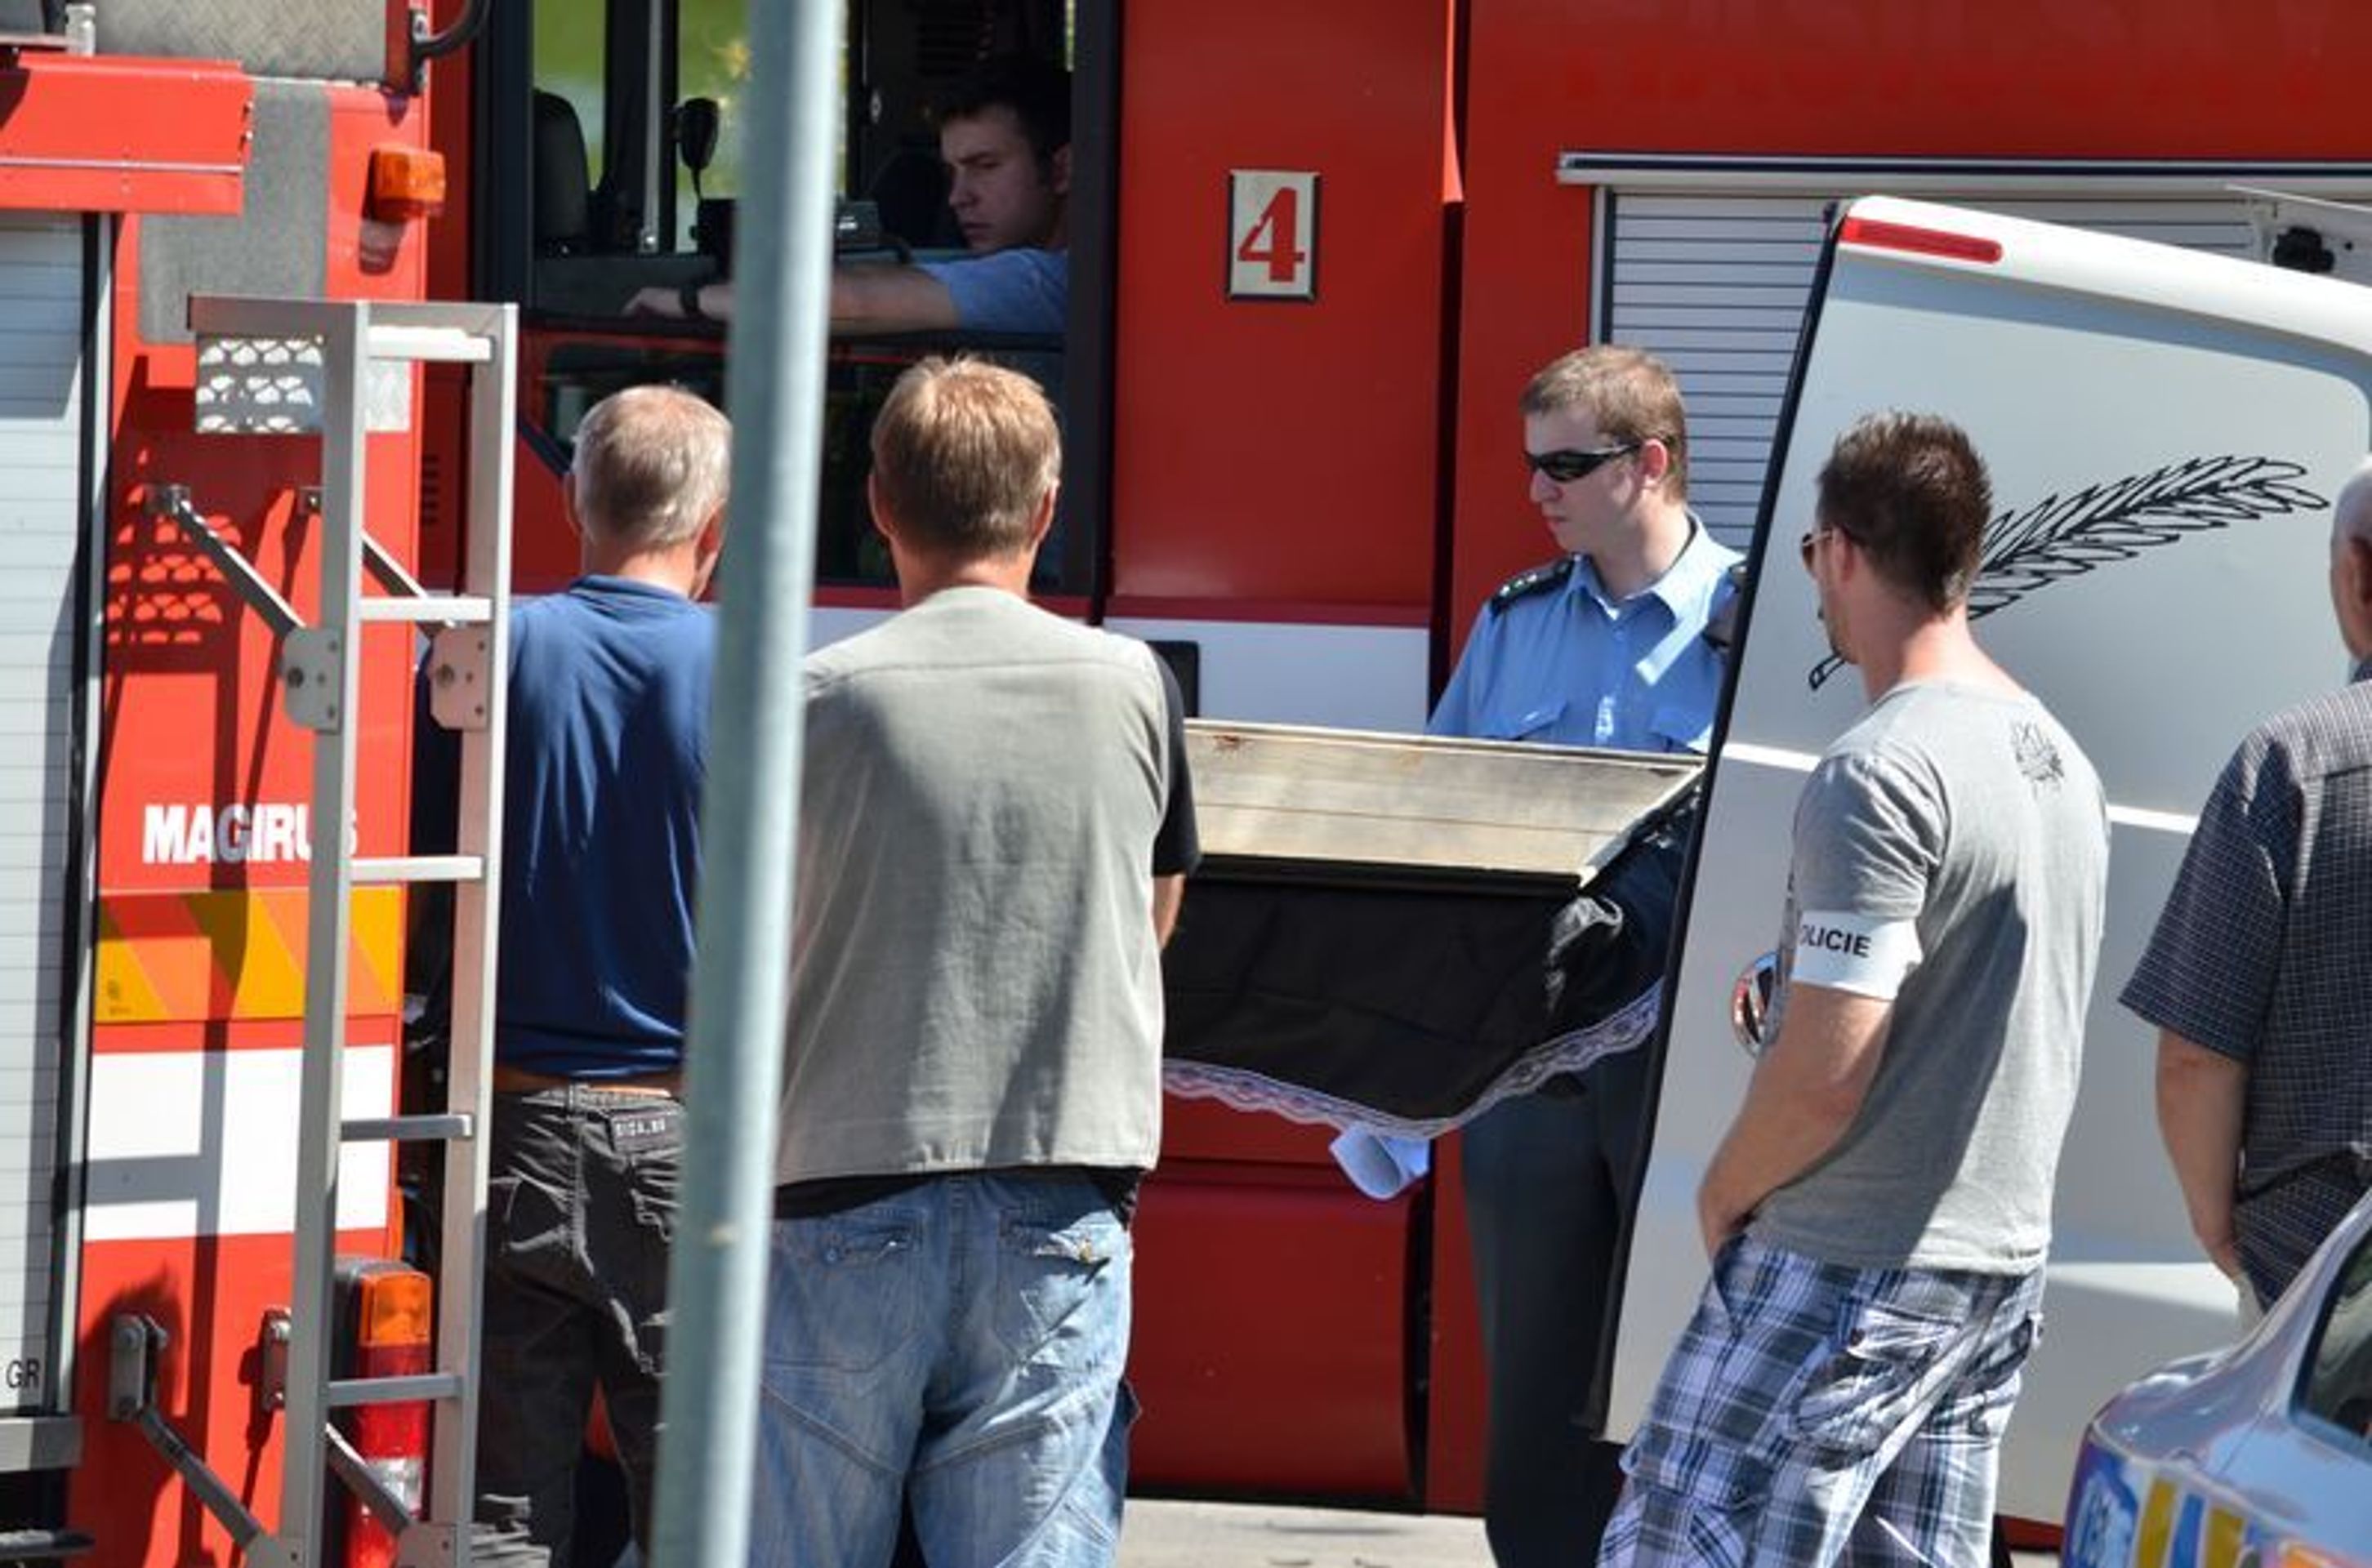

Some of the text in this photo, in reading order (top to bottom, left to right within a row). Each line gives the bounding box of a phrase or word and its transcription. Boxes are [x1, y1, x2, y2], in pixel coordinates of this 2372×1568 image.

[1237, 187, 1305, 282] 4
[143, 804, 358, 863] MAGIRU
[6, 1356, 40, 1388] GR
